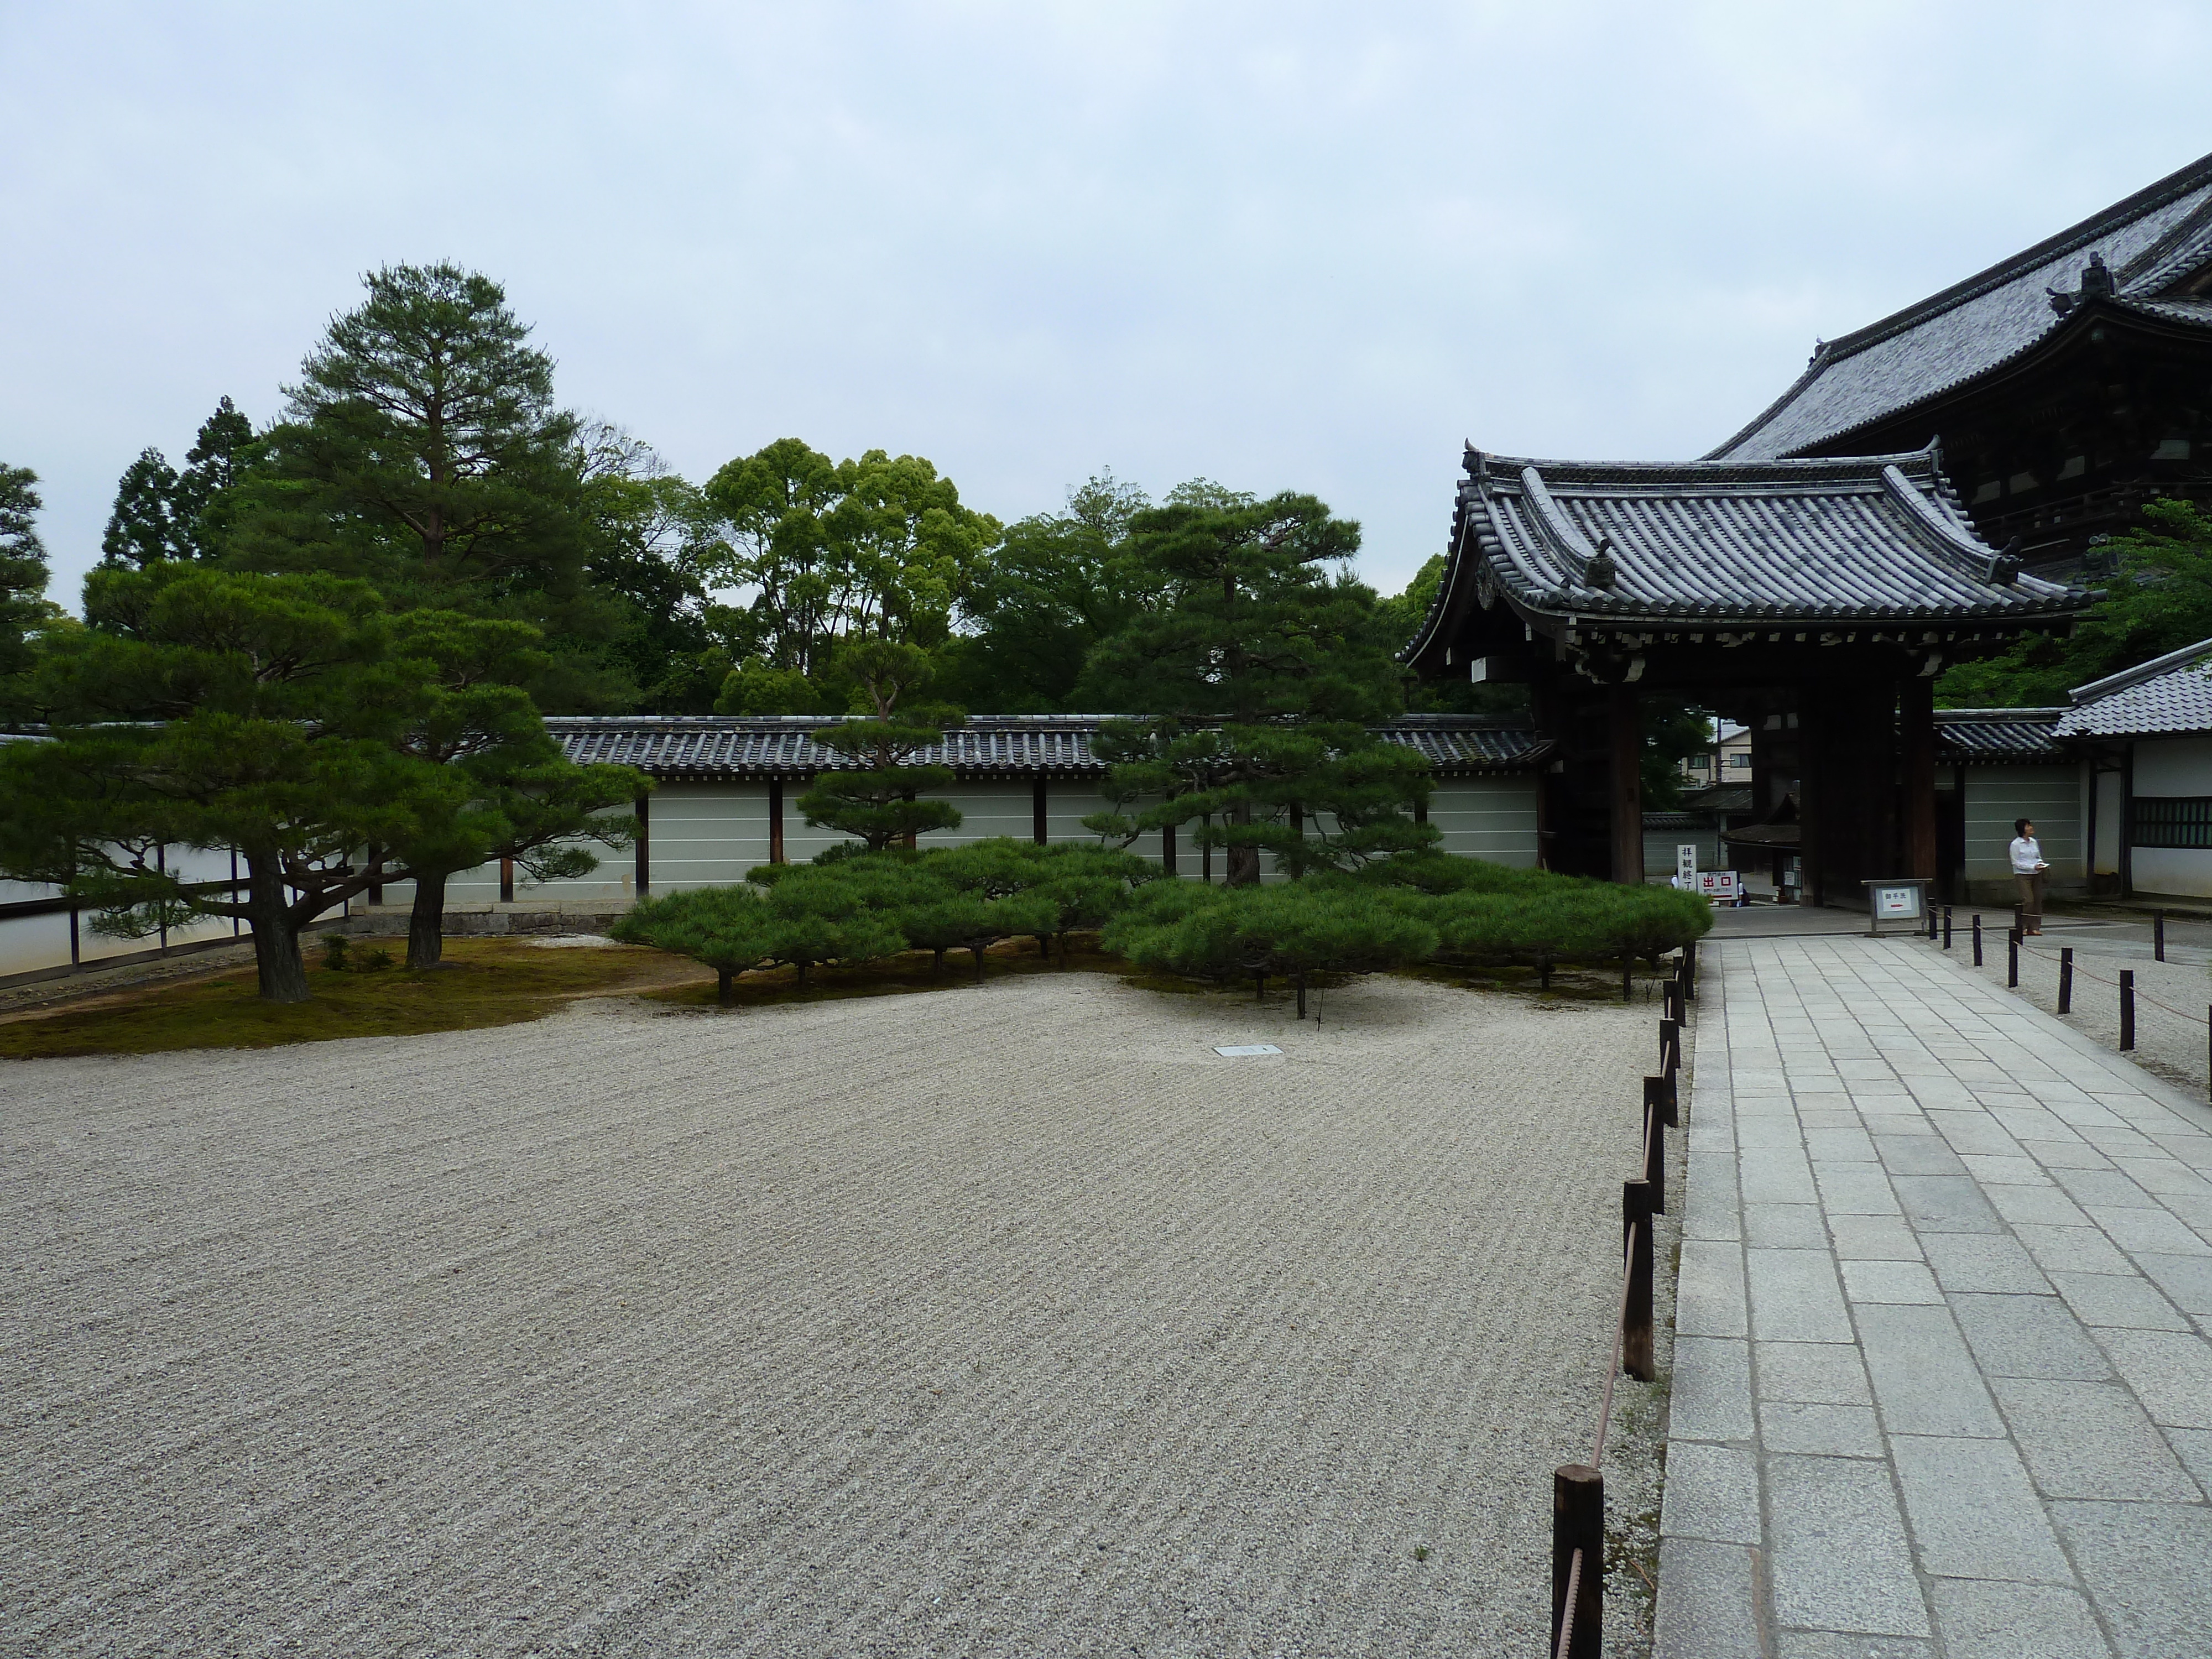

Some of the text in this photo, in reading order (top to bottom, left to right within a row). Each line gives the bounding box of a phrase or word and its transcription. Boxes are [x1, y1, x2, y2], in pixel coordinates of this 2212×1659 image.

[1682, 847, 1693, 890] 拝観終了
[1703, 877, 1731, 887] 出口
